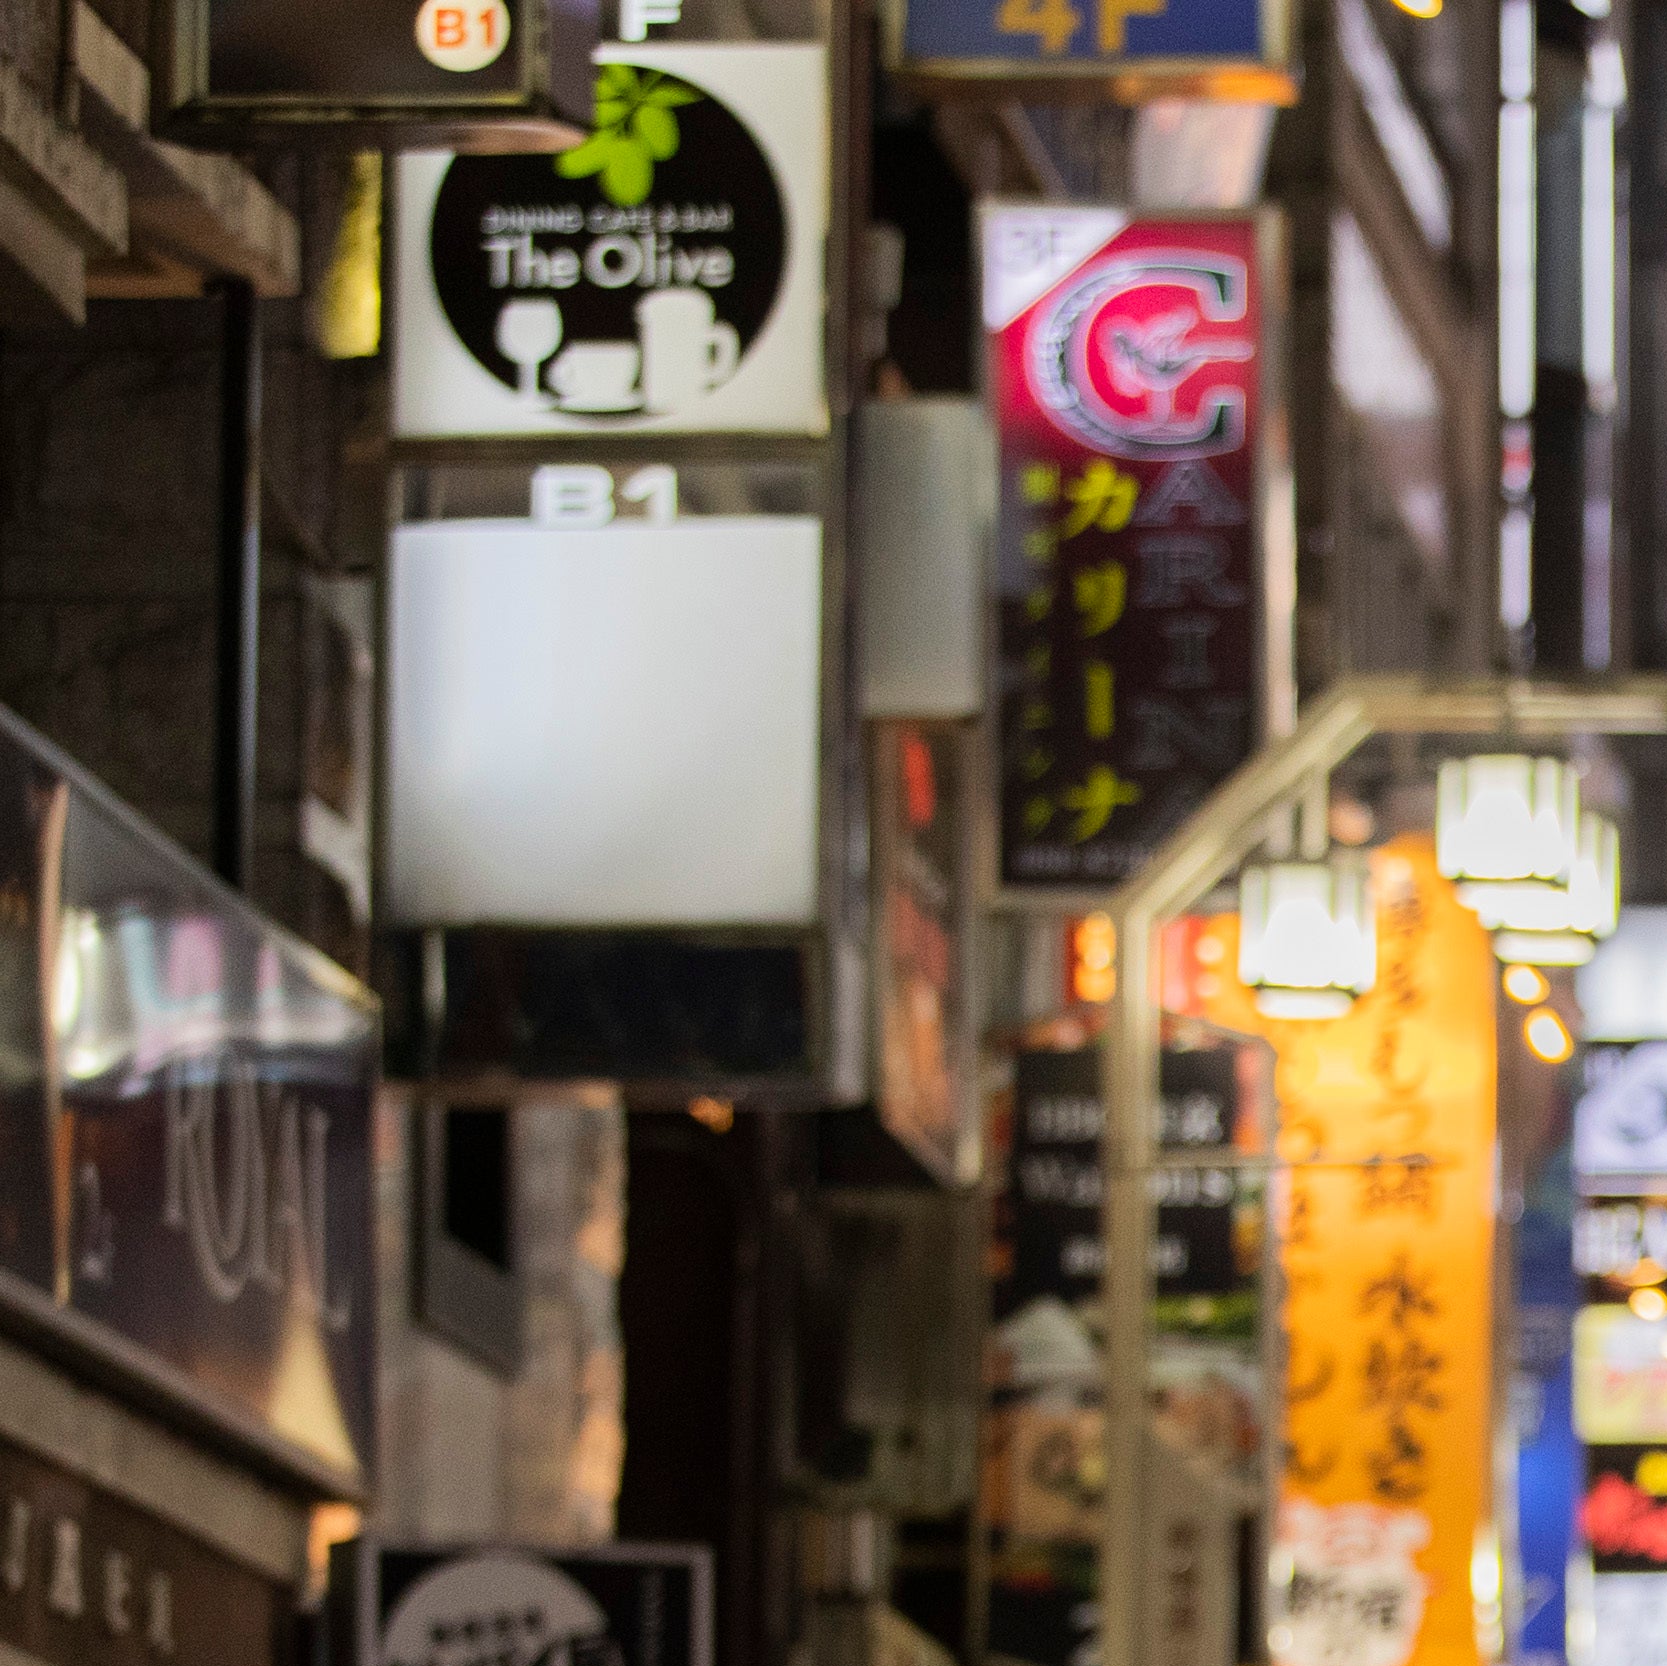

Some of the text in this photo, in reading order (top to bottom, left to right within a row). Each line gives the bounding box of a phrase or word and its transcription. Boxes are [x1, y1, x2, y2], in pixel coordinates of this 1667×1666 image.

[433, 8, 501, 49] B1
[485, 235, 735, 289] The Olive
[531, 463, 679, 527] B1
